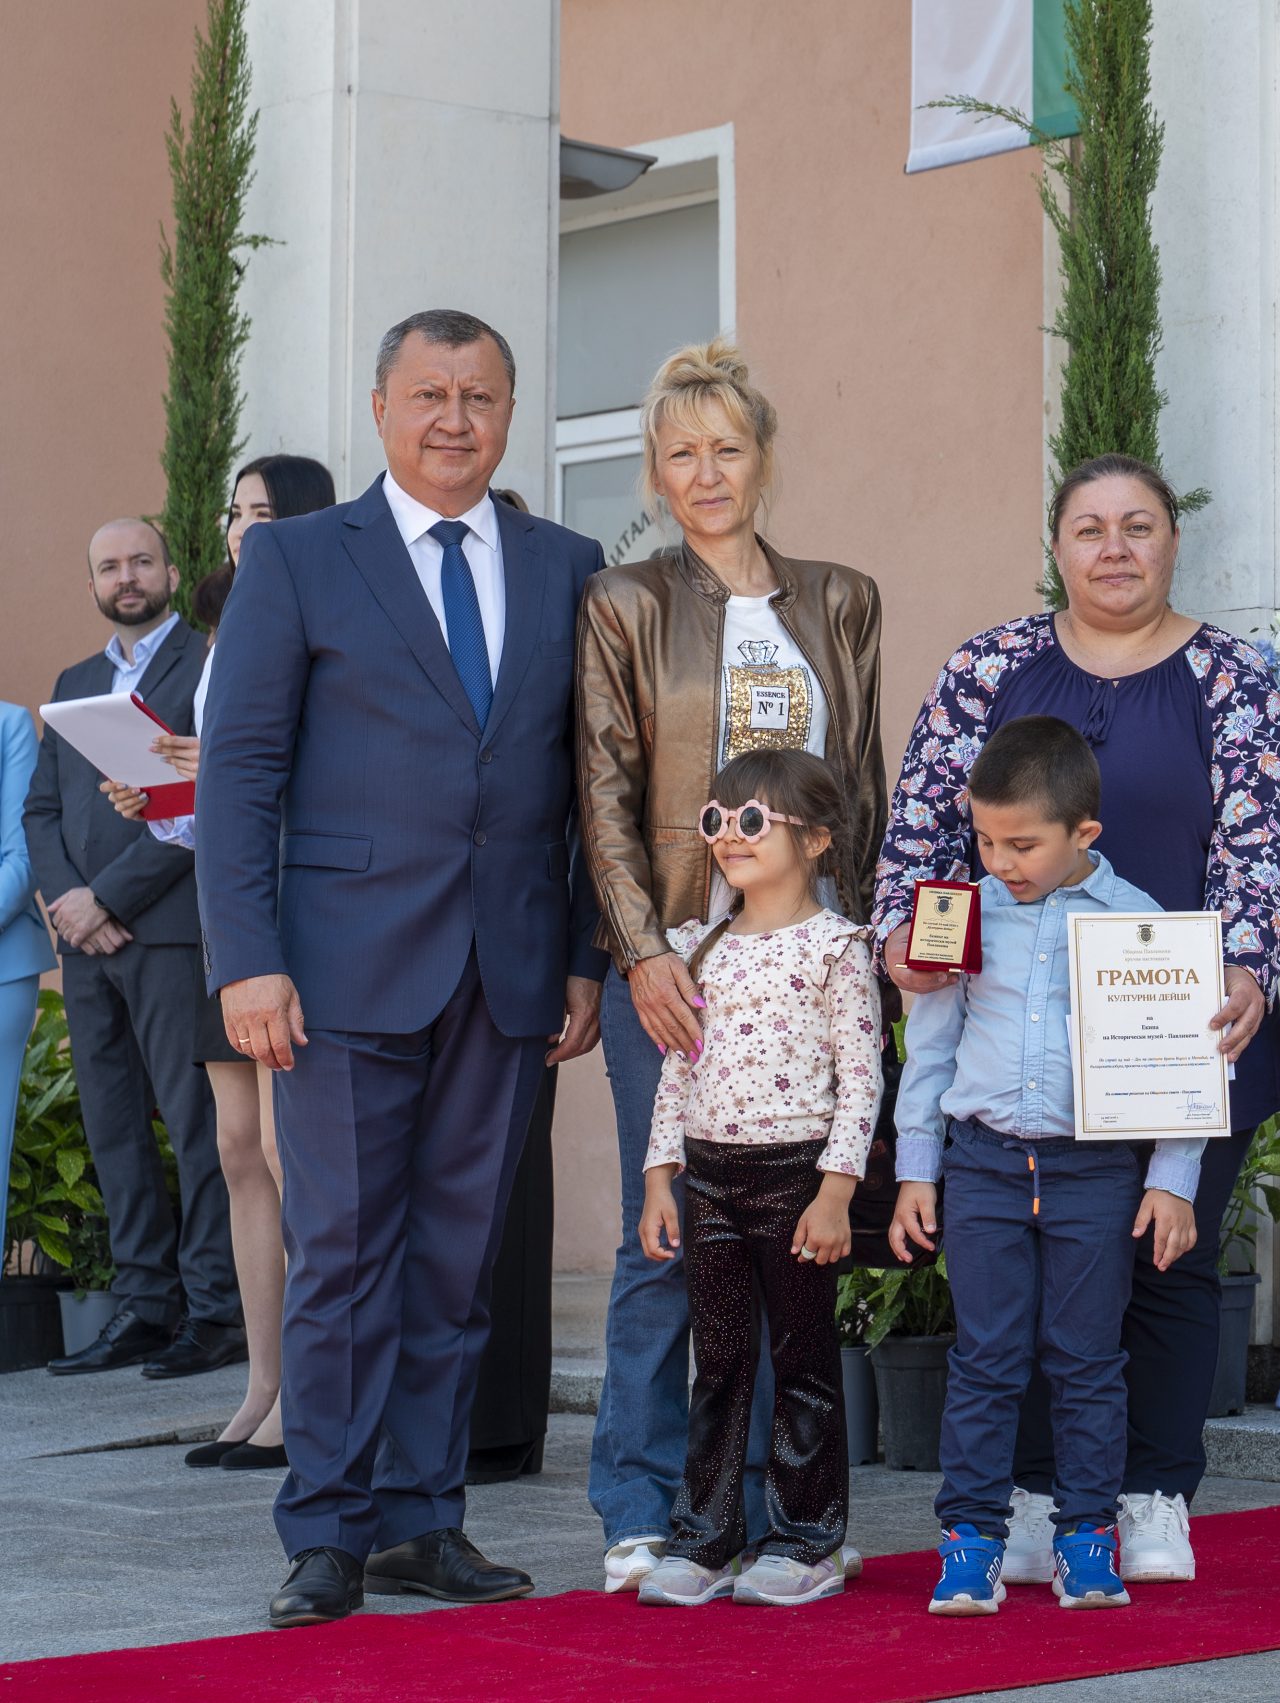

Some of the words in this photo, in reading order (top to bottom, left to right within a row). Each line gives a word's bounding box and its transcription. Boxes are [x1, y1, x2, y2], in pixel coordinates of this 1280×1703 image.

[756, 690, 786, 699] ESSENCE
[1096, 968, 1200, 986] ГРАМОТА
[1107, 994, 1156, 1003] КУЛТУРНИ
[1158, 992, 1191, 1002] ДЕЙЦИ
[1110, 1034, 1146, 1042] Исторически
[1147, 1033, 1164, 1041] музей
